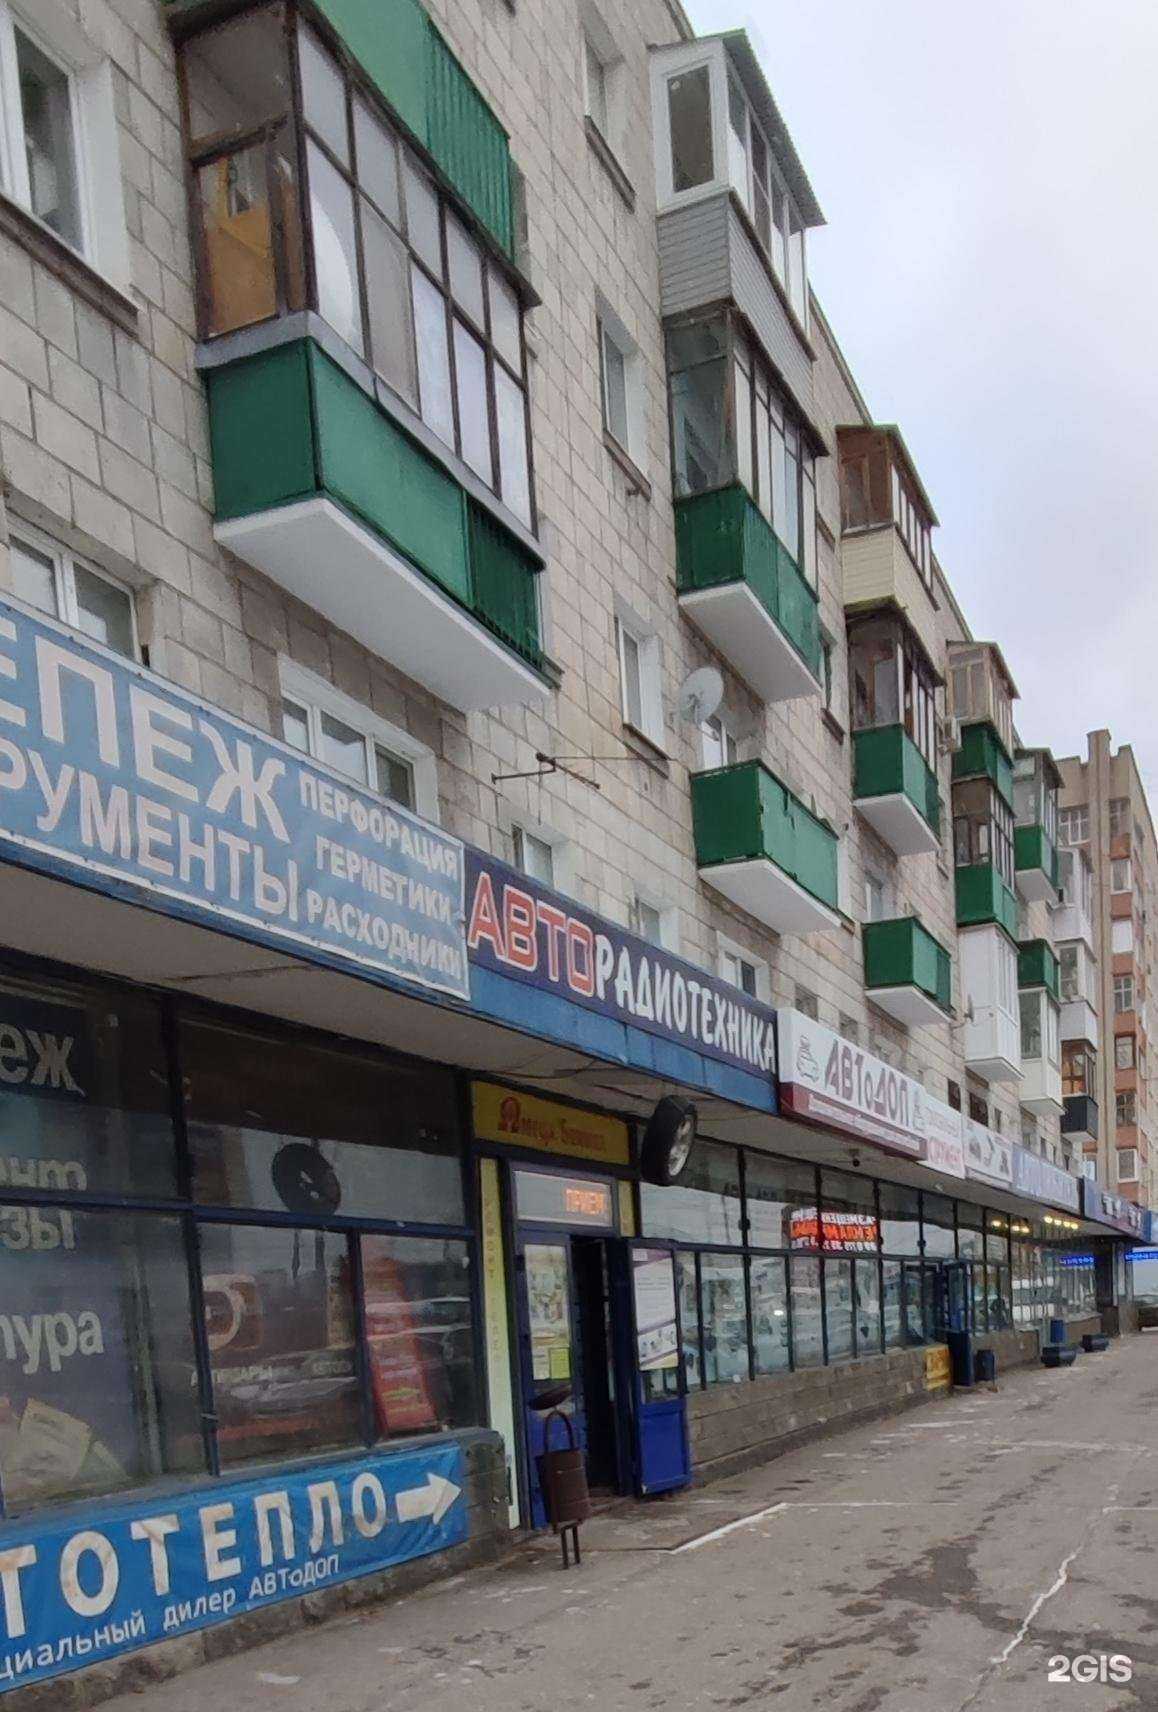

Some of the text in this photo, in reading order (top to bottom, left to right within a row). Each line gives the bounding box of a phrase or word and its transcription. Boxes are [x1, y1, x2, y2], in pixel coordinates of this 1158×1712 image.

[300, 772, 458, 880] ПЕРФОРАЦИЯ
[315, 834, 452, 925] ГЕРМЕТИКИ
[306, 888, 462, 980] РАСХОДНИКИ
[163, 1588, 236, 1632] дилер
